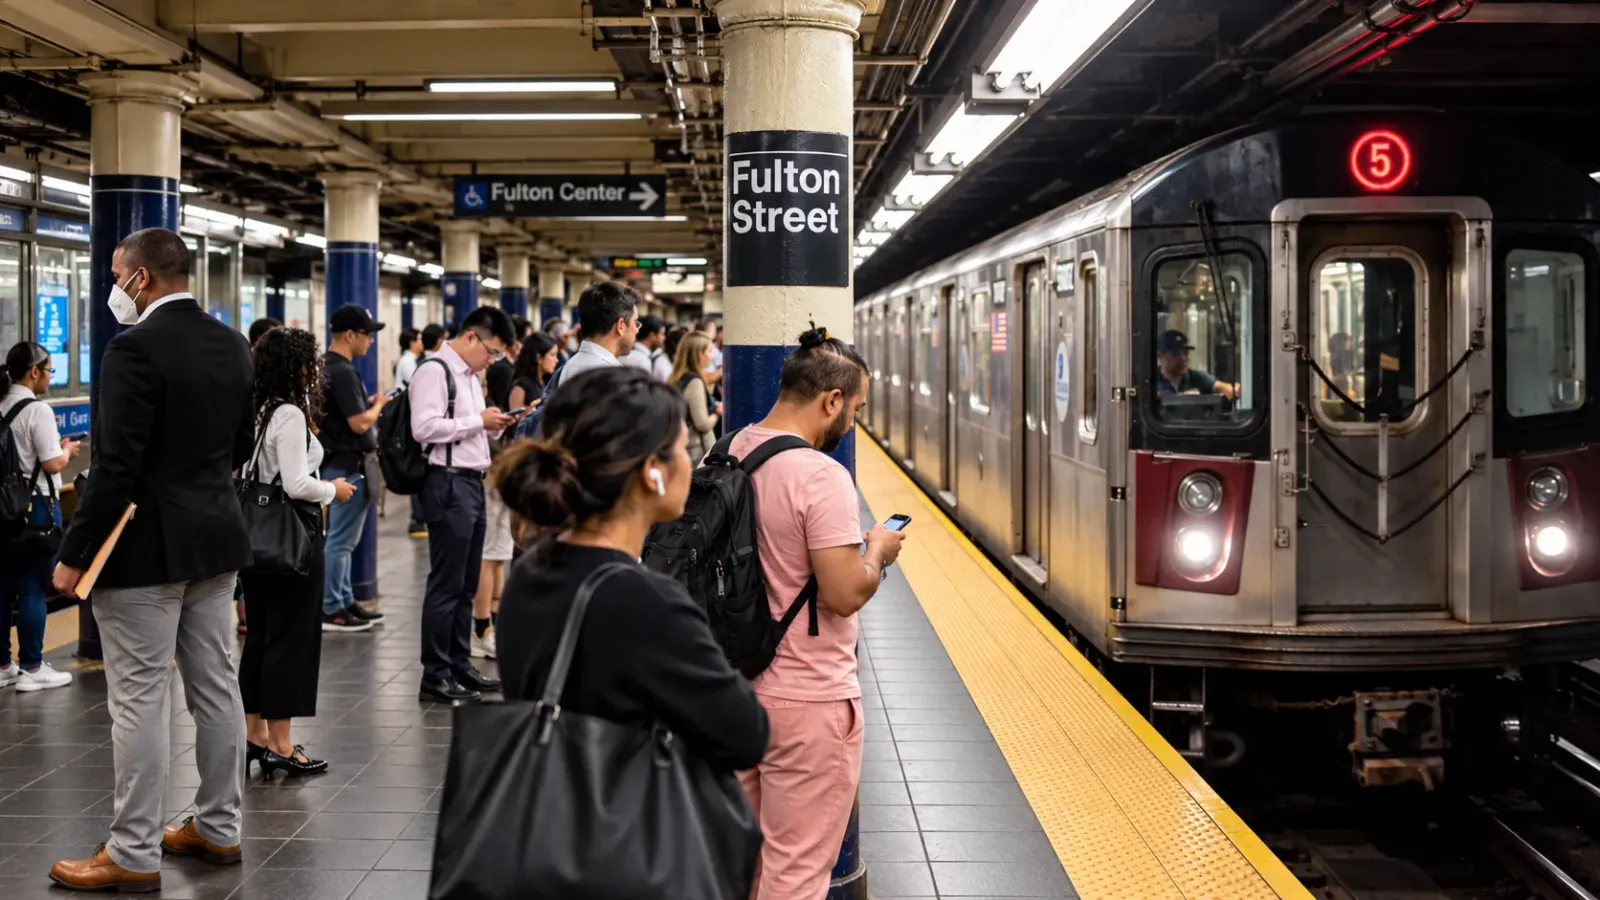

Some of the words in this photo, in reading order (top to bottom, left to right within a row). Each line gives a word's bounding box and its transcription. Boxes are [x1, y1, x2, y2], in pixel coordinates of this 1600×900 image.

[732, 159, 841, 194] Fulton
[1371, 143, 1391, 177] 5
[491, 182, 554, 201] Fulton
[560, 182, 625, 201] Center
[732, 200, 839, 234] Street
